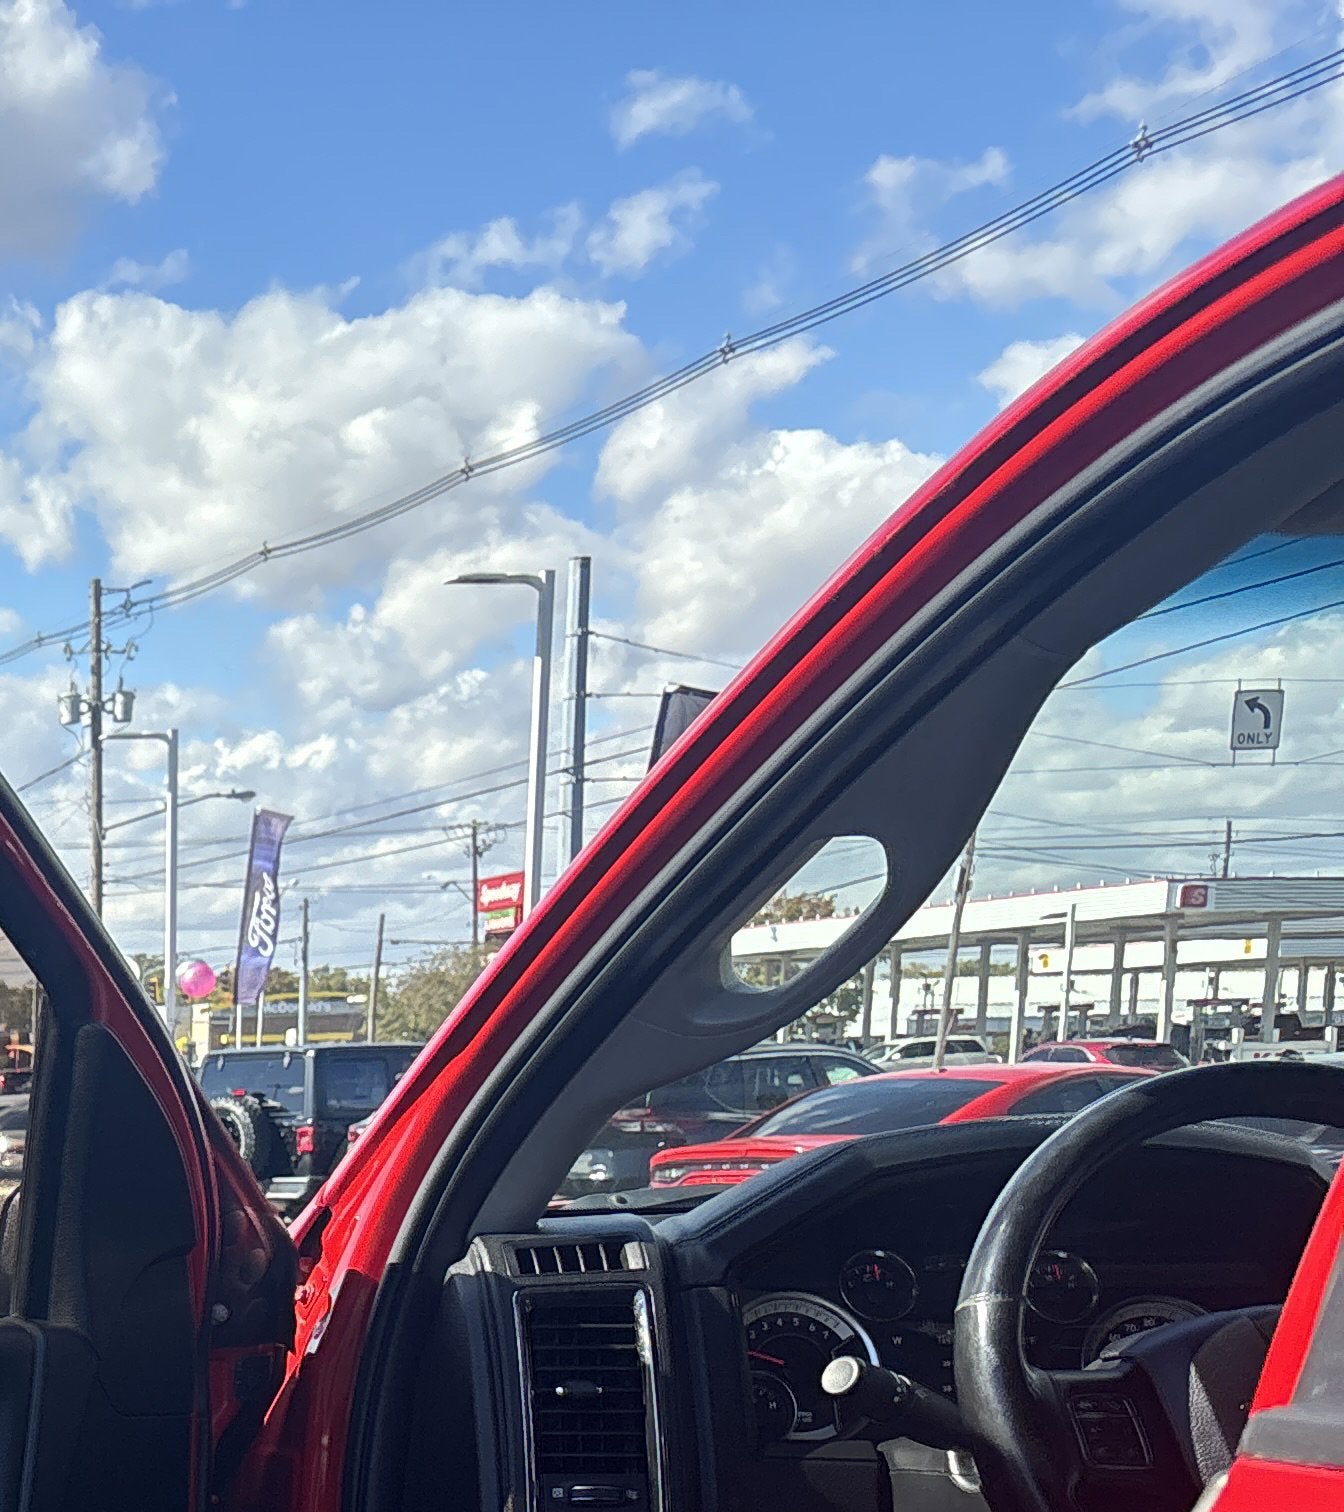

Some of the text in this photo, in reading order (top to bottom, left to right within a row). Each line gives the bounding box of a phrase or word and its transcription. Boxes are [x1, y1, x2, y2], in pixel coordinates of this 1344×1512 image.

[1237, 732, 1273, 745] ONLY
[1191, 888, 1206, 905] S
[792, 1317, 801, 1327] 5
[808, 1323, 817, 1332] 6
